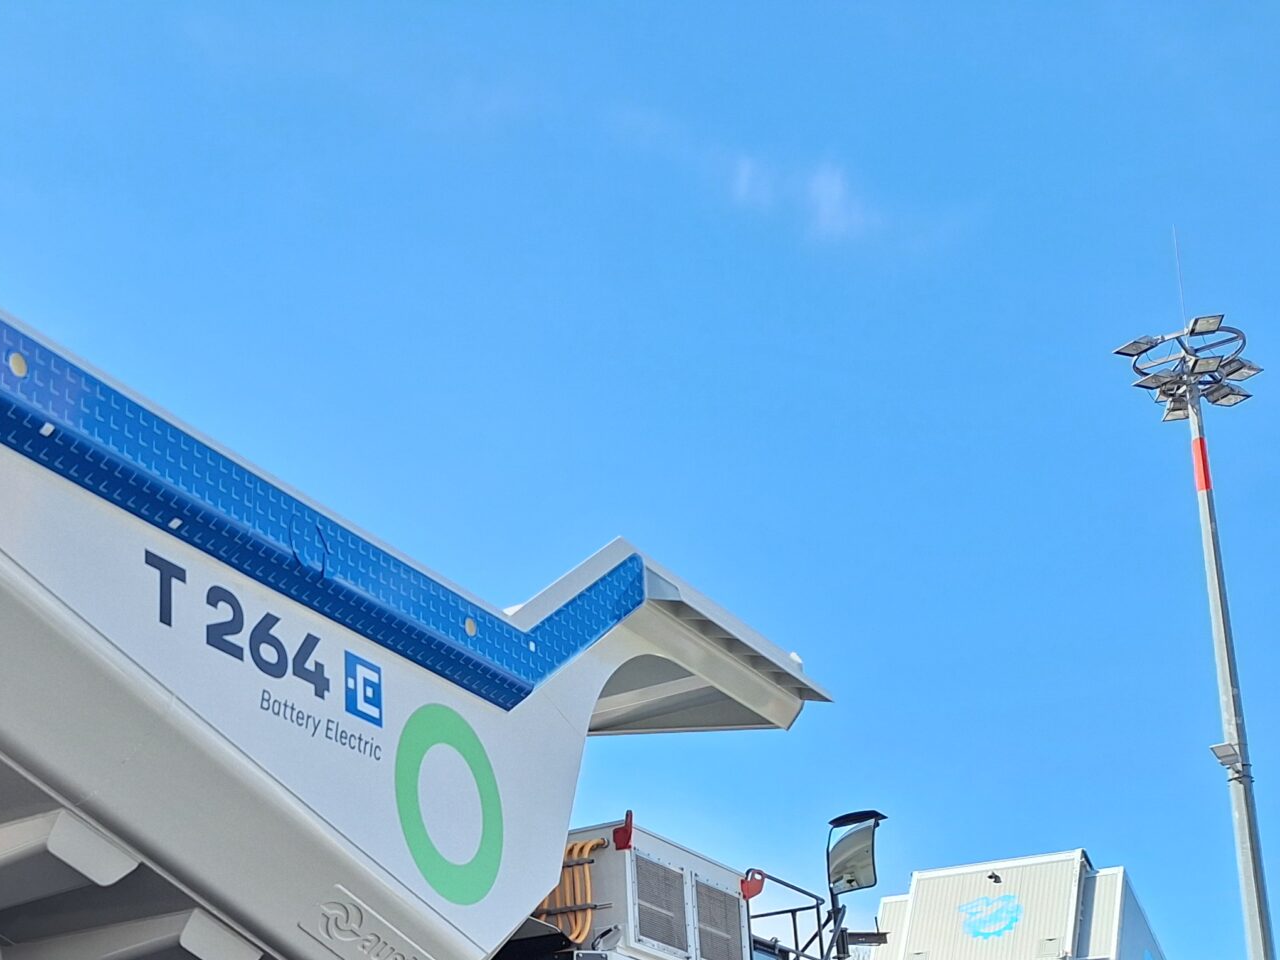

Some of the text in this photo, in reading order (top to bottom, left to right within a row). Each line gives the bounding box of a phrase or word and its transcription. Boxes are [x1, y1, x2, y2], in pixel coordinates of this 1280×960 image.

[145, 548, 331, 700] T 264
[259, 689, 382, 761] Battery Electric
